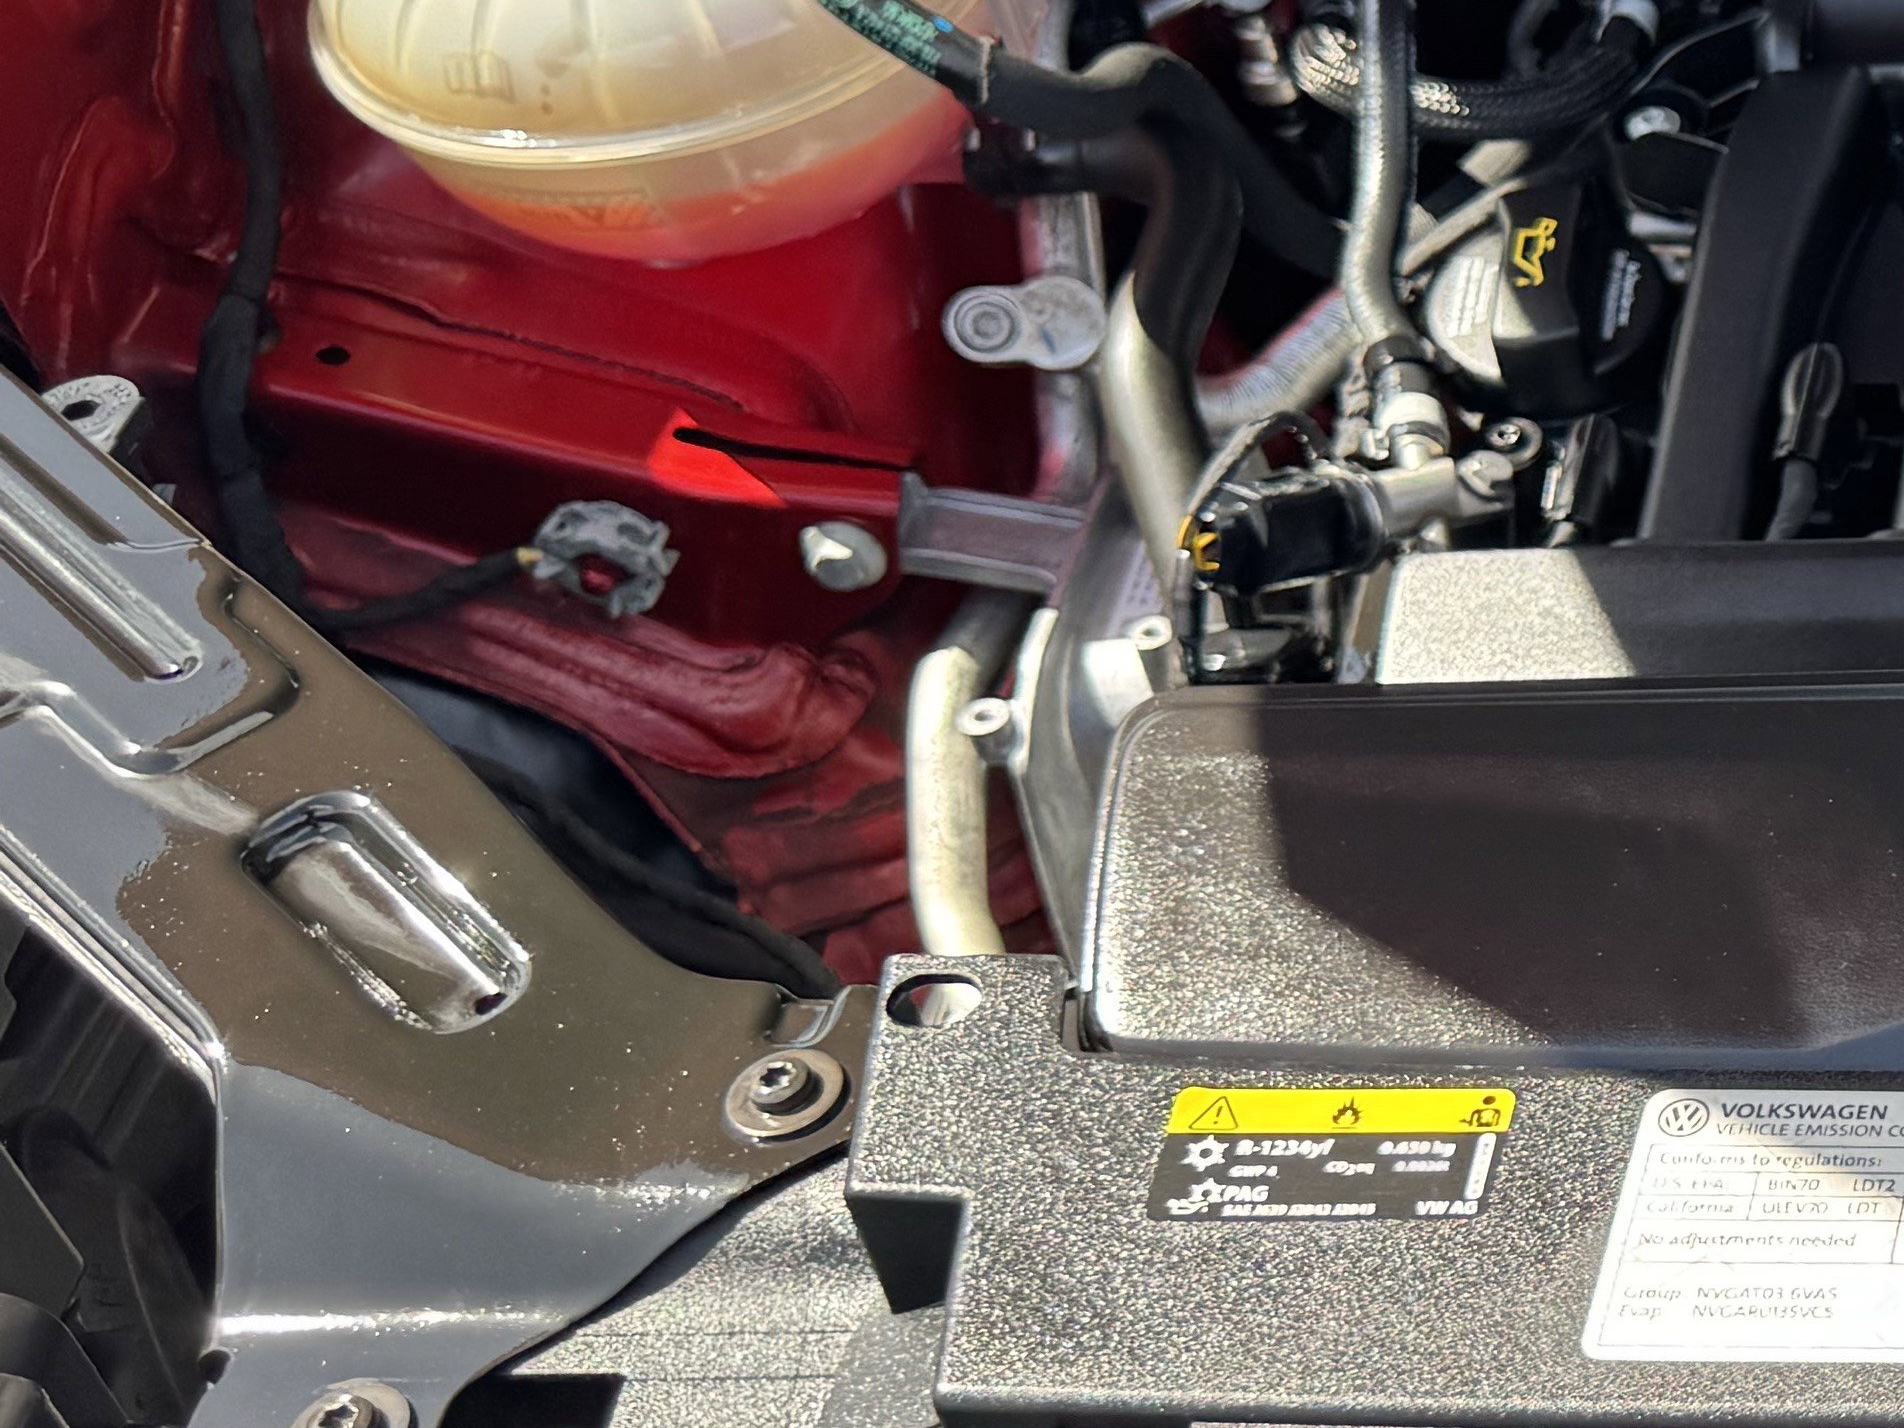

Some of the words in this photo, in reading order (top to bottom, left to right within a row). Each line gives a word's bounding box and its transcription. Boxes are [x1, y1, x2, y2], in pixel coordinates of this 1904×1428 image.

[1721, 1103, 1888, 1120] VOLKSWAGEN
[1717, 1123, 1790, 1136] VEHICLE
[1795, 1123, 1882, 1137] EMISSION
[1853, 1180, 1896, 1191] LDT2
[1223, 1185, 1269, 1202] PAG
[1415, 1201, 1449, 1214] VW
[1450, 1201, 1478, 1214] AG
